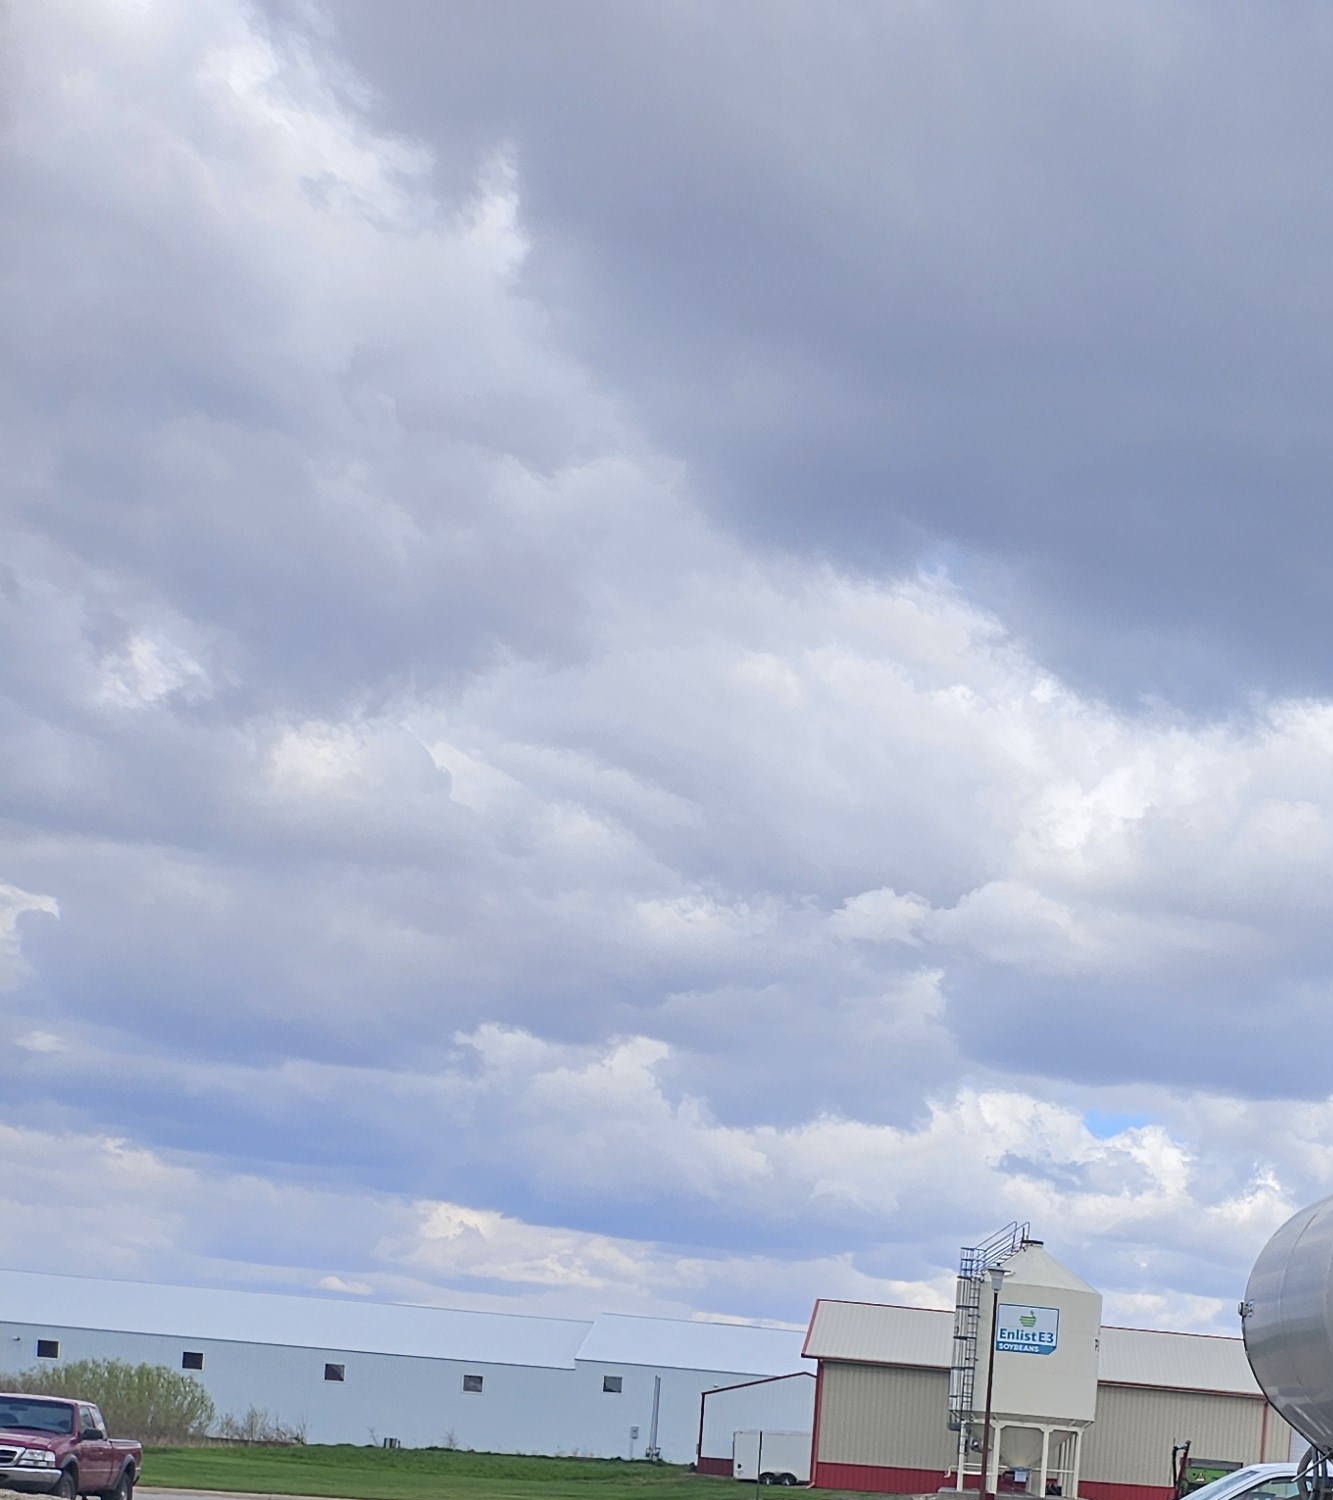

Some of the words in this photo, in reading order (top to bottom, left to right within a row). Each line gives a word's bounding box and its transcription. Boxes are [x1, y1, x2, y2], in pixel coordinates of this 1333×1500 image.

[999, 1328, 1037, 1342] Enlist
[1038, 1331, 1054, 1344] E3
[998, 1343, 1040, 1353] SOYBEANS
